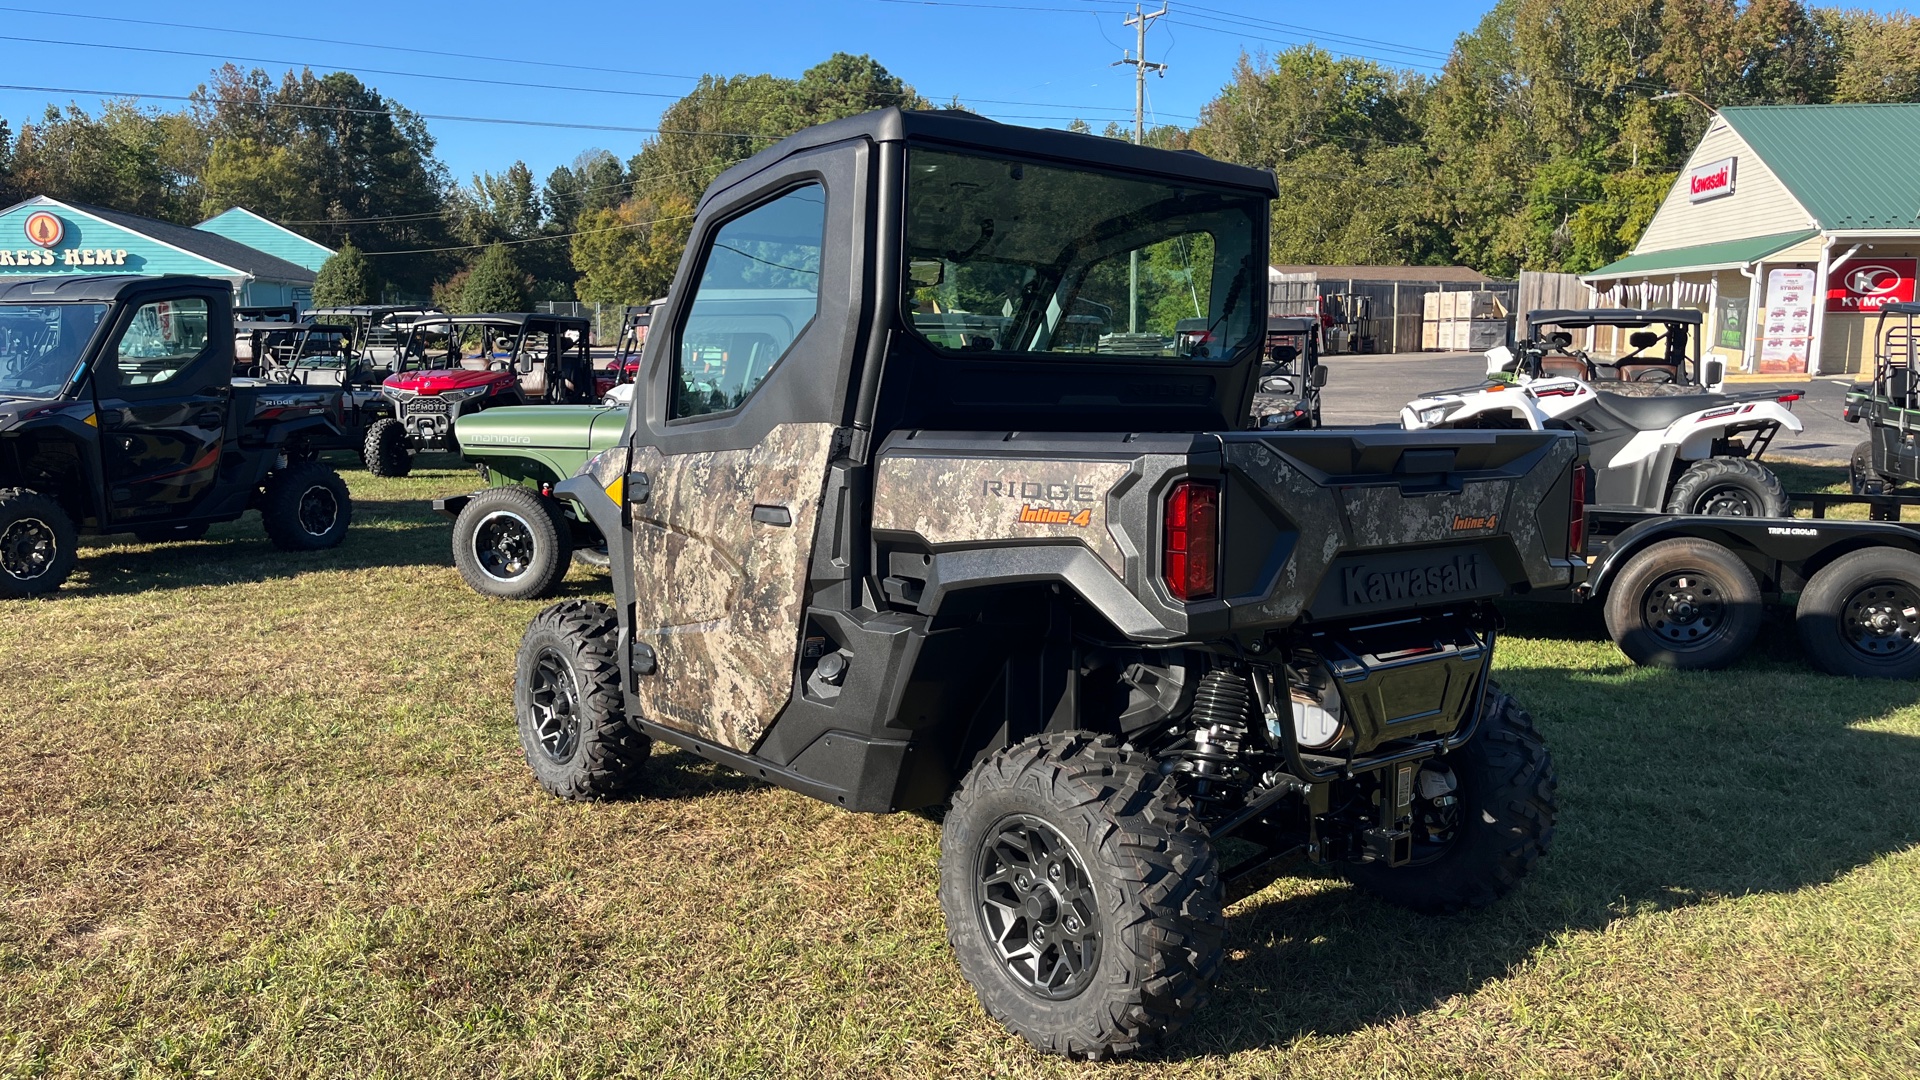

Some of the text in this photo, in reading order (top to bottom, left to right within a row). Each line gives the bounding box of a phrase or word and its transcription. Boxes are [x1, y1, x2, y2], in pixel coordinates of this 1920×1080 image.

[1691, 166, 1727, 194] Kawasaki
[64, 249, 127, 265] HEMP
[410, 403, 447, 411] CFMOTO
[471, 433, 531, 443] mahindra
[983, 480, 1094, 501] RIDGE
[1018, 503, 1092, 528] Inline-4
[1452, 514, 1497, 531] Inline-4
[1768, 527, 1790, 535] TRIPLE
[1343, 554, 1481, 606] Kawasaki
[652, 694, 711, 728] Kawasaki
